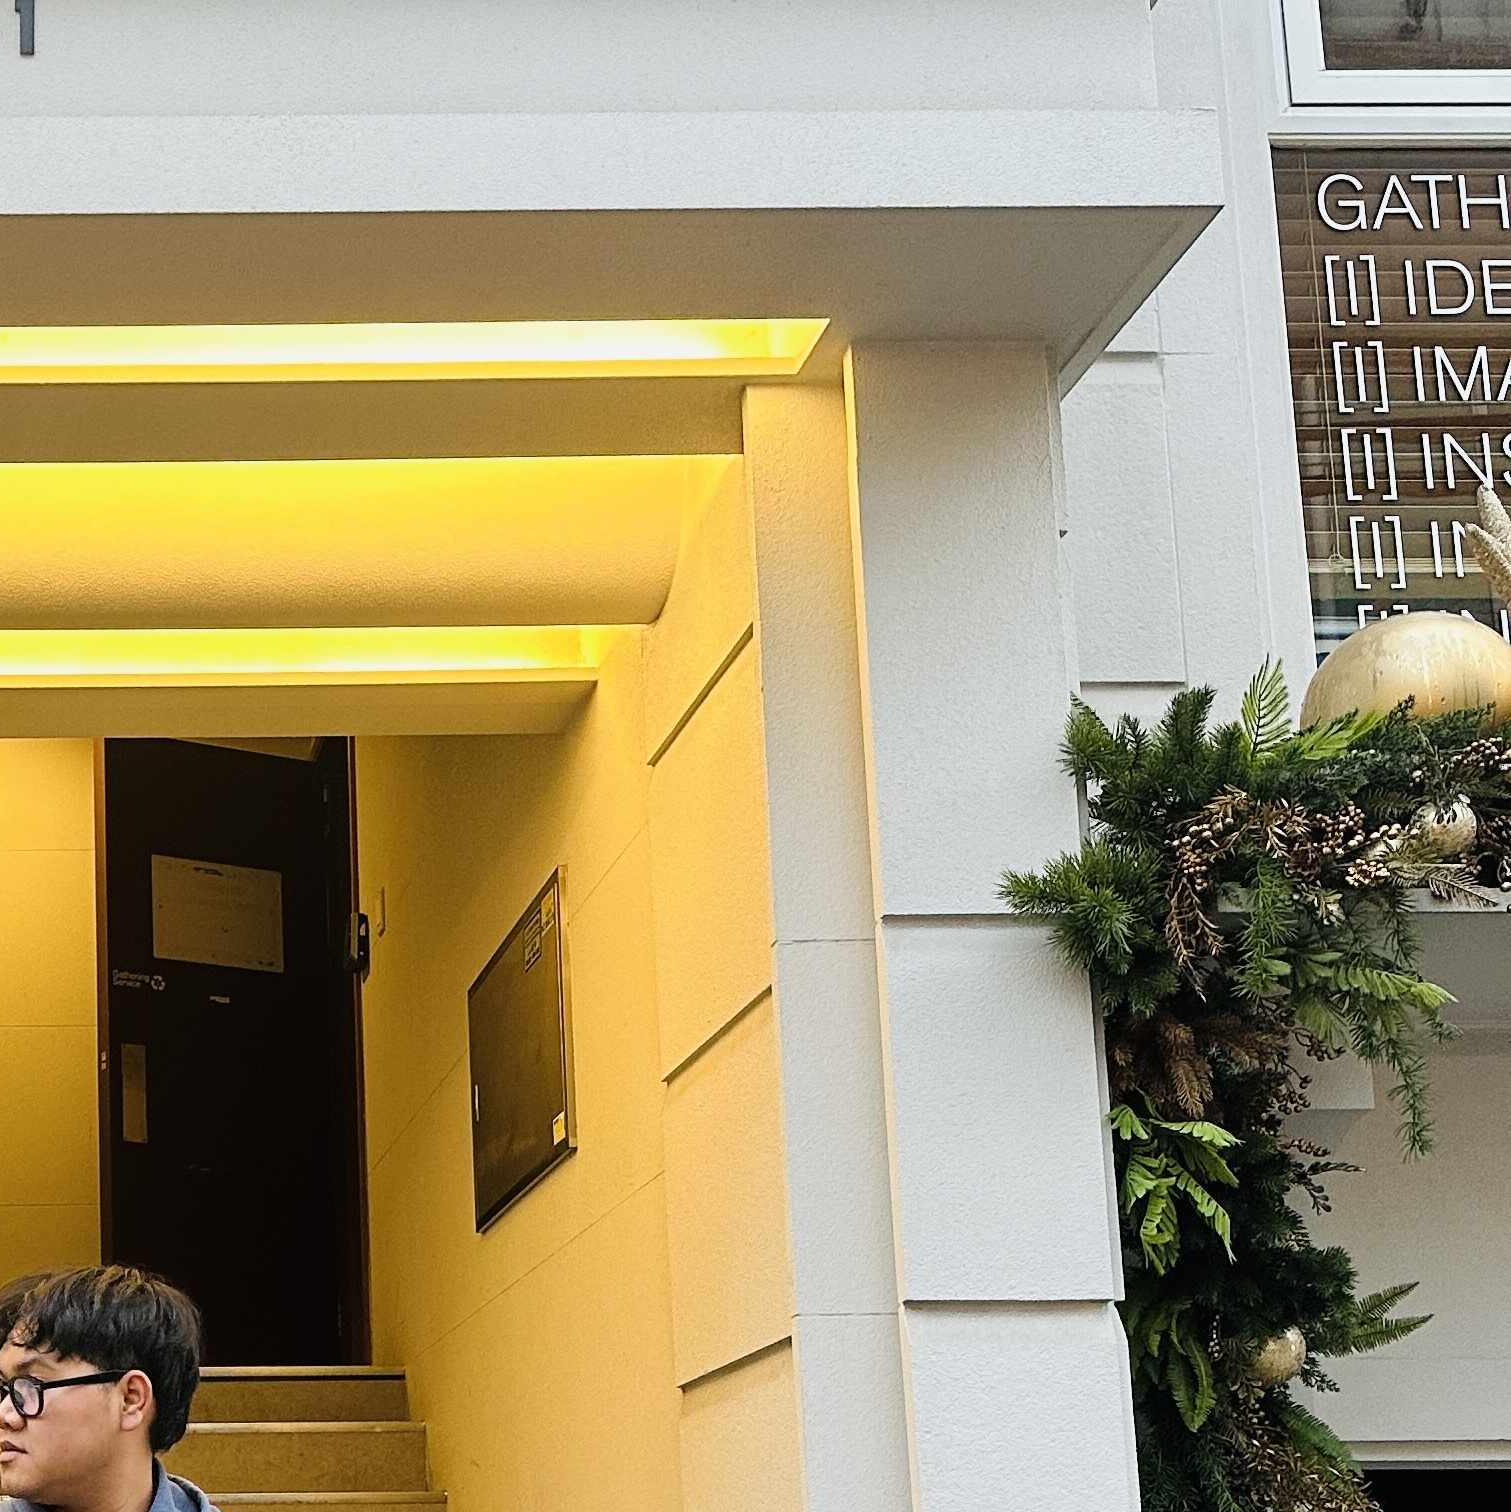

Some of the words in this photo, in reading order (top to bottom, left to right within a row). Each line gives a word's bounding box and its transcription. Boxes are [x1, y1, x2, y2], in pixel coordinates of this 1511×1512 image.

[1317, 173, 1510, 231] GATH
[1413, 345, 1511, 401] IM
[1422, 432, 1511, 489] IN
